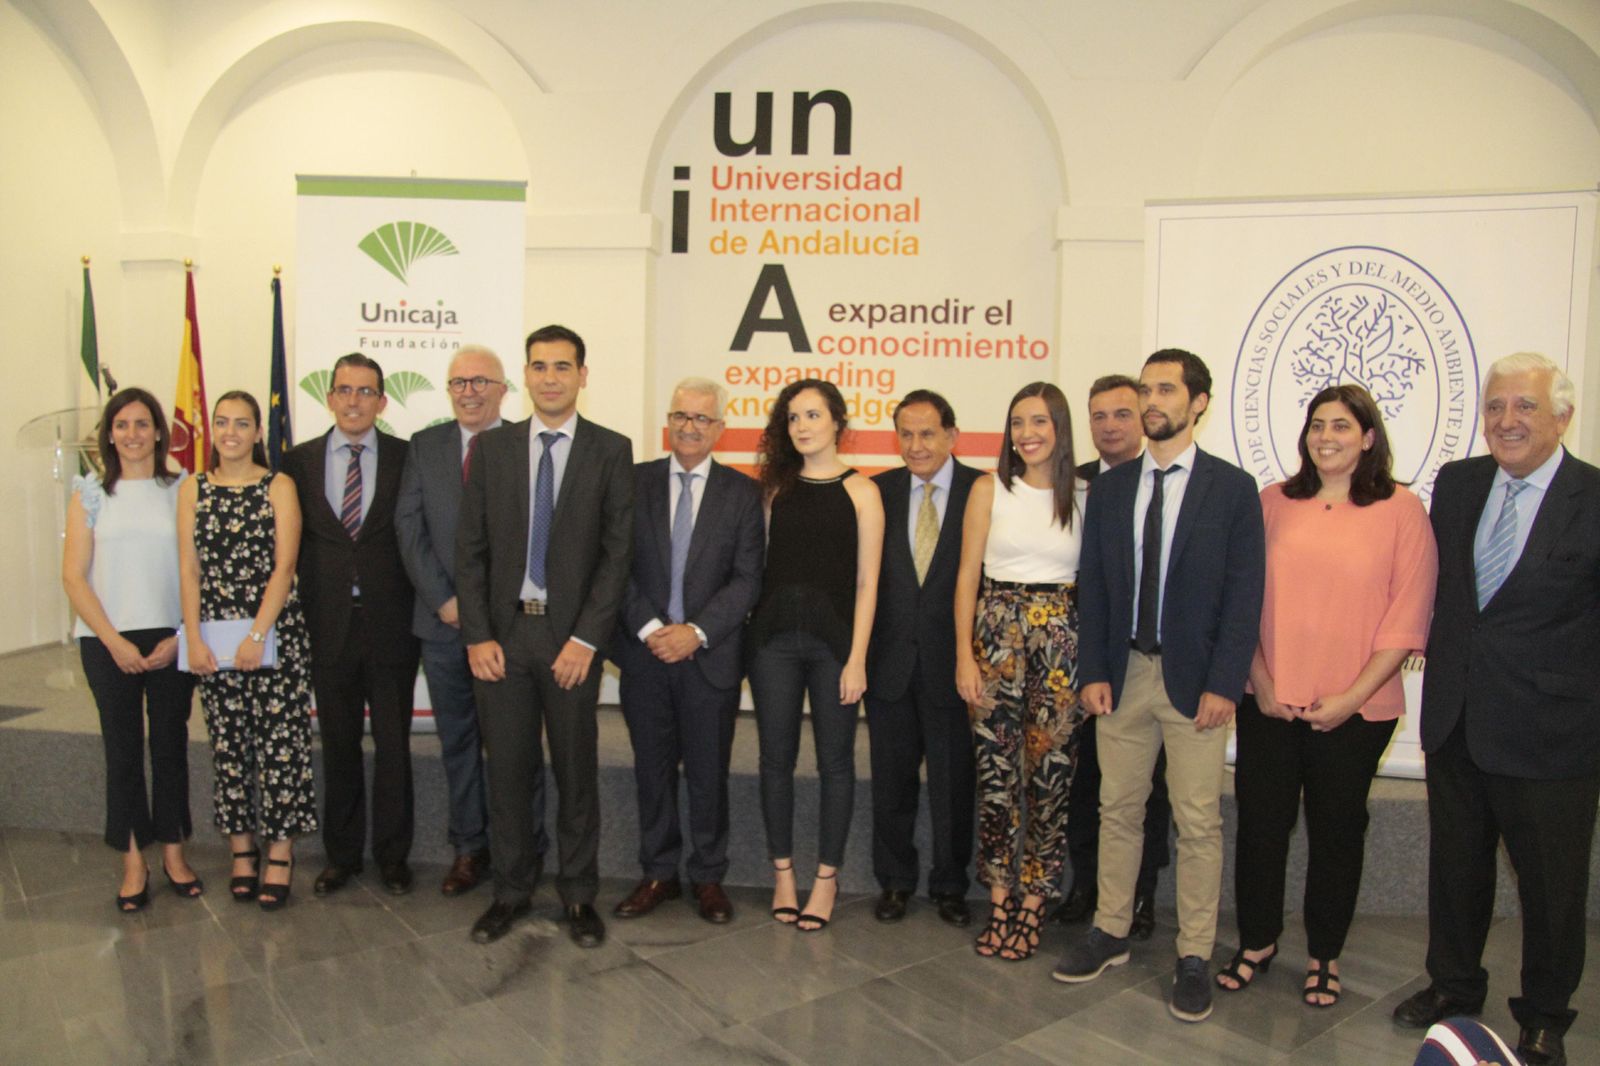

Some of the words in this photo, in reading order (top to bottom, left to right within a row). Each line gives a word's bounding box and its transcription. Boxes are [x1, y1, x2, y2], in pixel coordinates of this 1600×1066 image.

[713, 89, 852, 157] un
[711, 166, 903, 192] Universidad
[671, 166, 690, 253] i
[710, 197, 920, 223] Internacional
[709, 229, 747, 255] de
[758, 229, 919, 256] Andalucía
[1331, 263, 1342, 277] Y
[1349, 261, 1388, 280] DEL
[729, 264, 812, 353] A
[1259, 269, 1328, 343] SOCIALES
[1390, 270, 1445, 325] MEDIO
[361, 299, 459, 330] Unicaja
[829, 299, 975, 329] expandir
[984, 299, 1013, 326] el
[360, 336, 461, 350] Fundación
[817, 331, 1049, 360] conocimiento
[725, 361, 896, 395] expanding
[1245, 345, 1268, 433] CIENCIAS
[1436, 329, 1464, 430] AMBIENTE
[1248, 436, 1266, 463] DE
